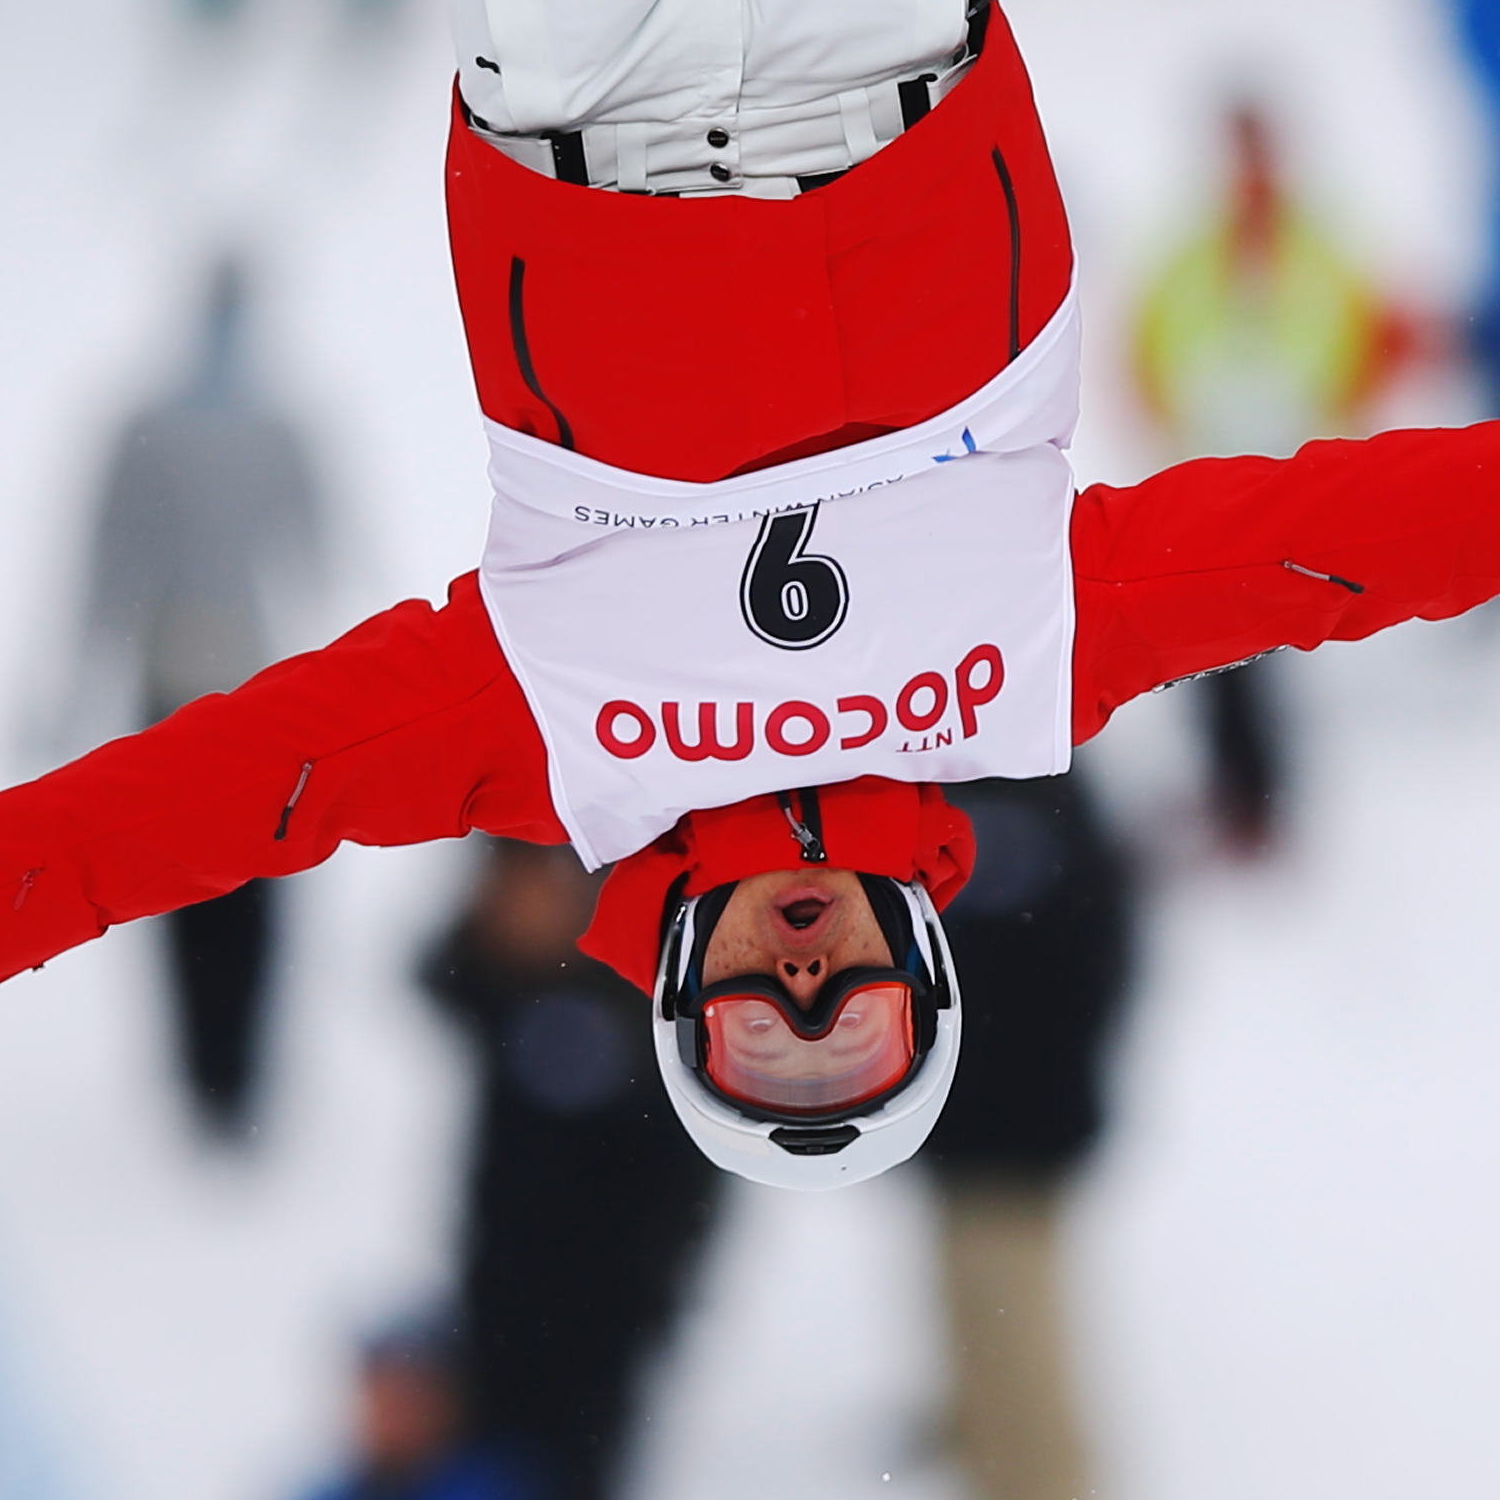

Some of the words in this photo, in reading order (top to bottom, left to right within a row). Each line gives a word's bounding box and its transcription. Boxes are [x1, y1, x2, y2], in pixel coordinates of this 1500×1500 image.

[574, 506, 679, 529] GAMES
[740, 500, 850, 652] 9
[595, 644, 1006, 762] docomo
[895, 726, 954, 754] NTT
